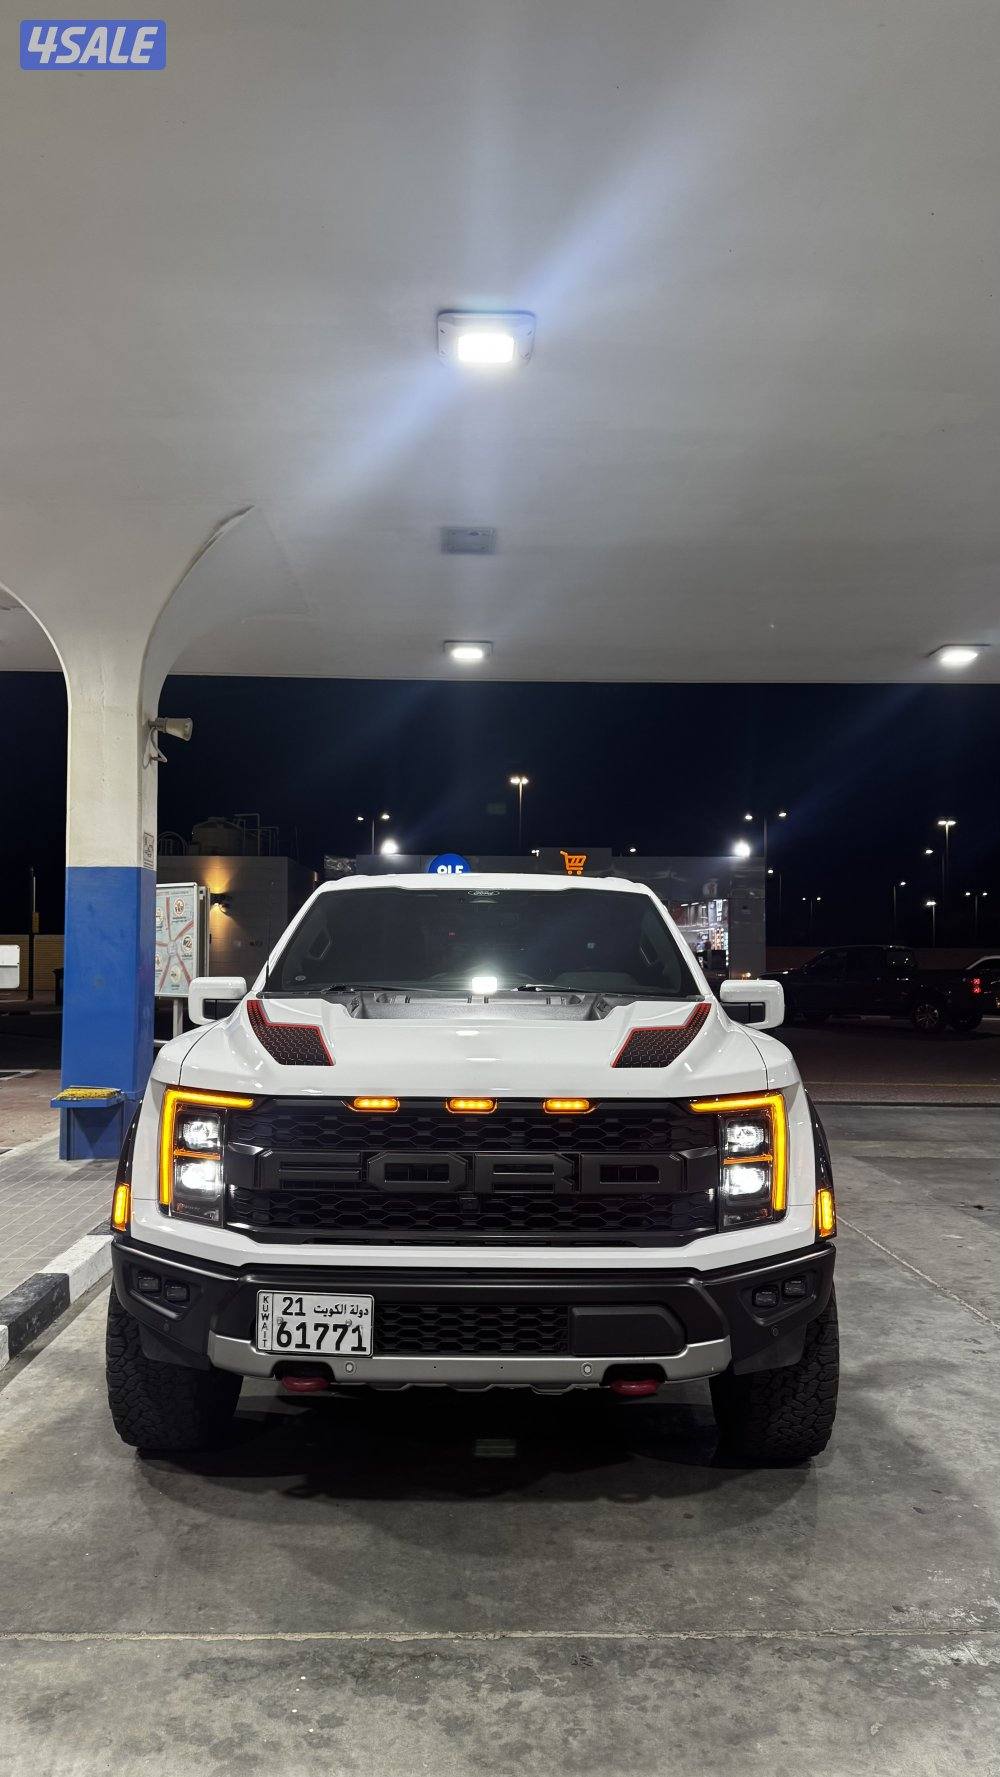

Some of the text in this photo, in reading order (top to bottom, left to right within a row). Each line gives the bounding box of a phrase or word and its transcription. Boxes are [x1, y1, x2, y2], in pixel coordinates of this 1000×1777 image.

[260, 1150, 688, 1194] FORD
[261, 1296, 270, 1348] KUWAIT
[281, 1296, 306, 1317] 21
[313, 1303, 369, 1318] دولة الكويت
[276, 1321, 367, 1352] 61771
